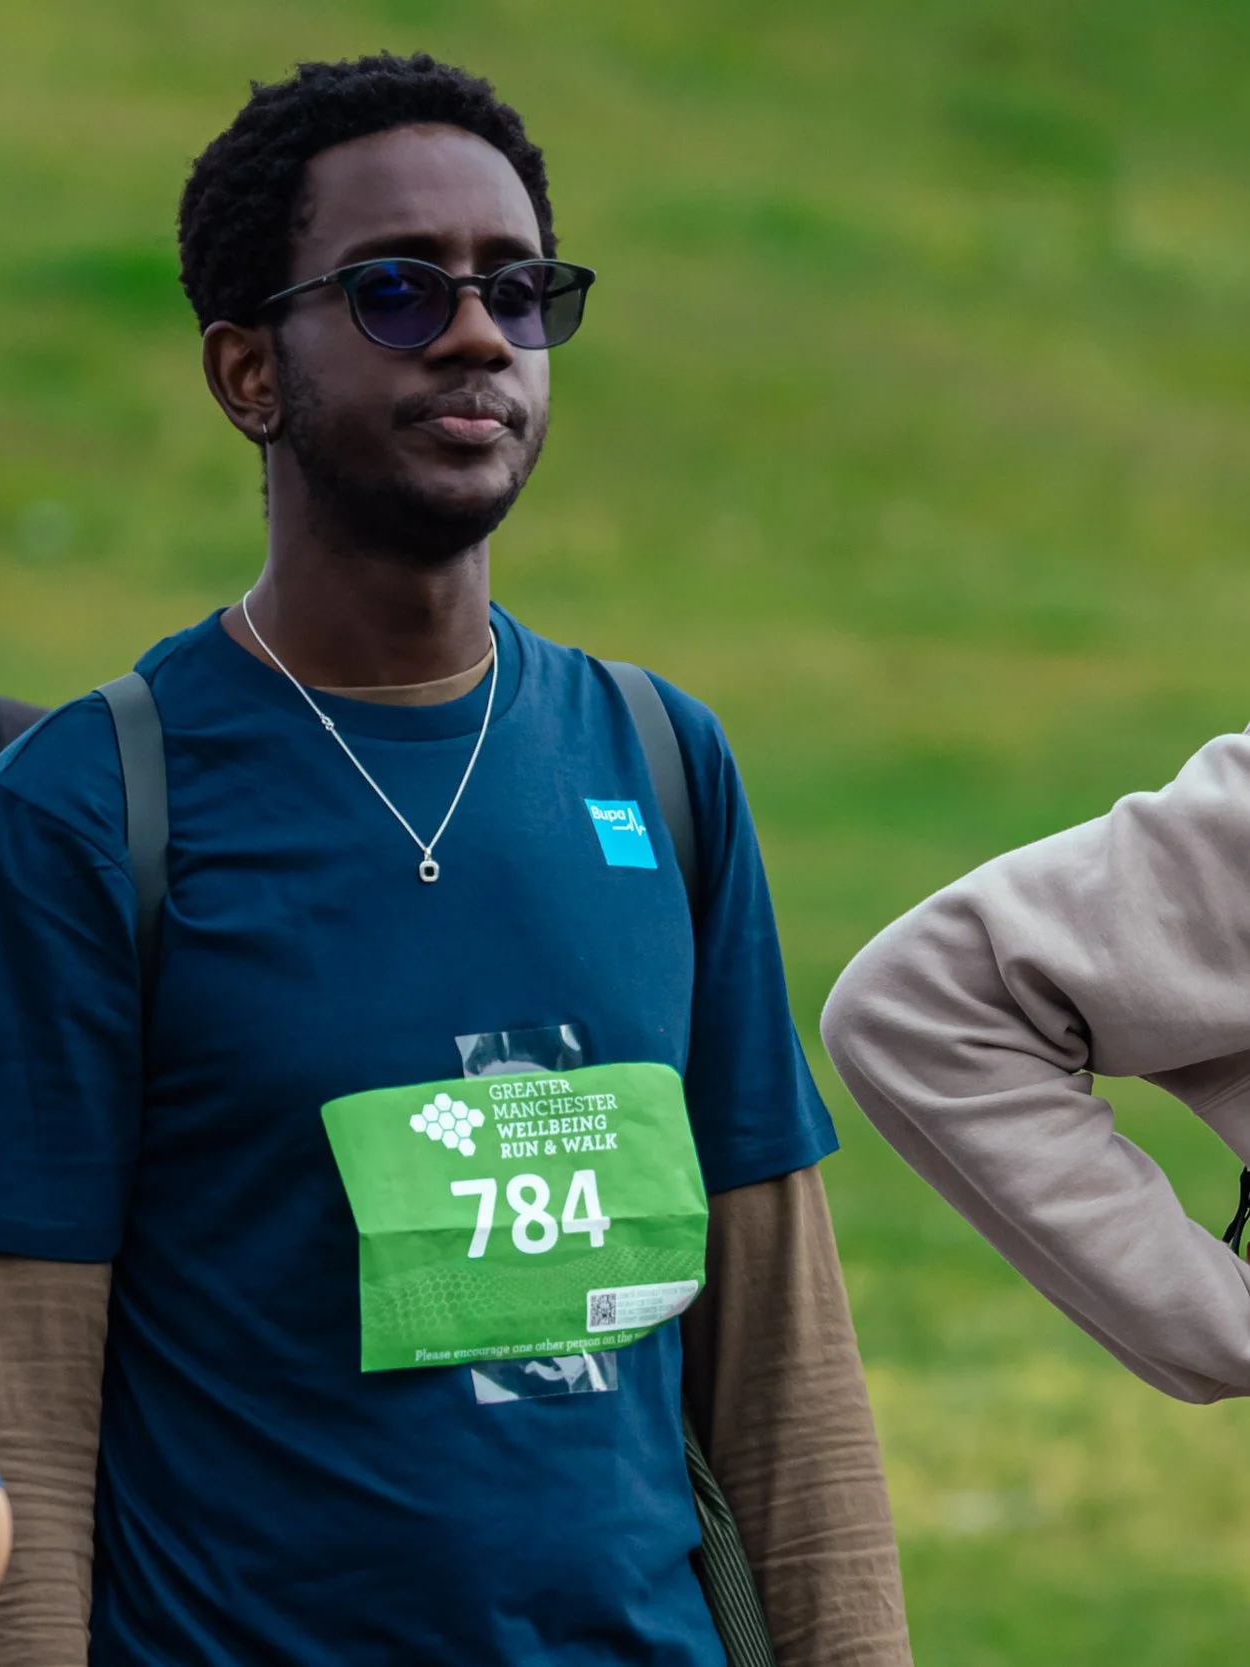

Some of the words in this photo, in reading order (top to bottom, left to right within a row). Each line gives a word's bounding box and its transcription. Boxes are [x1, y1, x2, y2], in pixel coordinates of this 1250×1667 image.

[590, 806, 627, 822] Bupa
[489, 1079, 574, 1101] GREATER
[493, 1093, 618, 1120] MANCHESTER
[496, 1114, 607, 1139] WELLBEING
[500, 1140, 539, 1160] RUN
[544, 1139, 557, 1155] &
[562, 1133, 618, 1153] WALK
[450, 1169, 611, 1258] 784
[415, 1348, 451, 1361] Please
[454, 1345, 510, 1359] encourage
[512, 1343, 533, 1353] one
[535, 1338, 564, 1352] other
[566, 1338, 600, 1351] person
[602, 1335, 615, 1344] on
[617, 1331, 633, 1344] the
